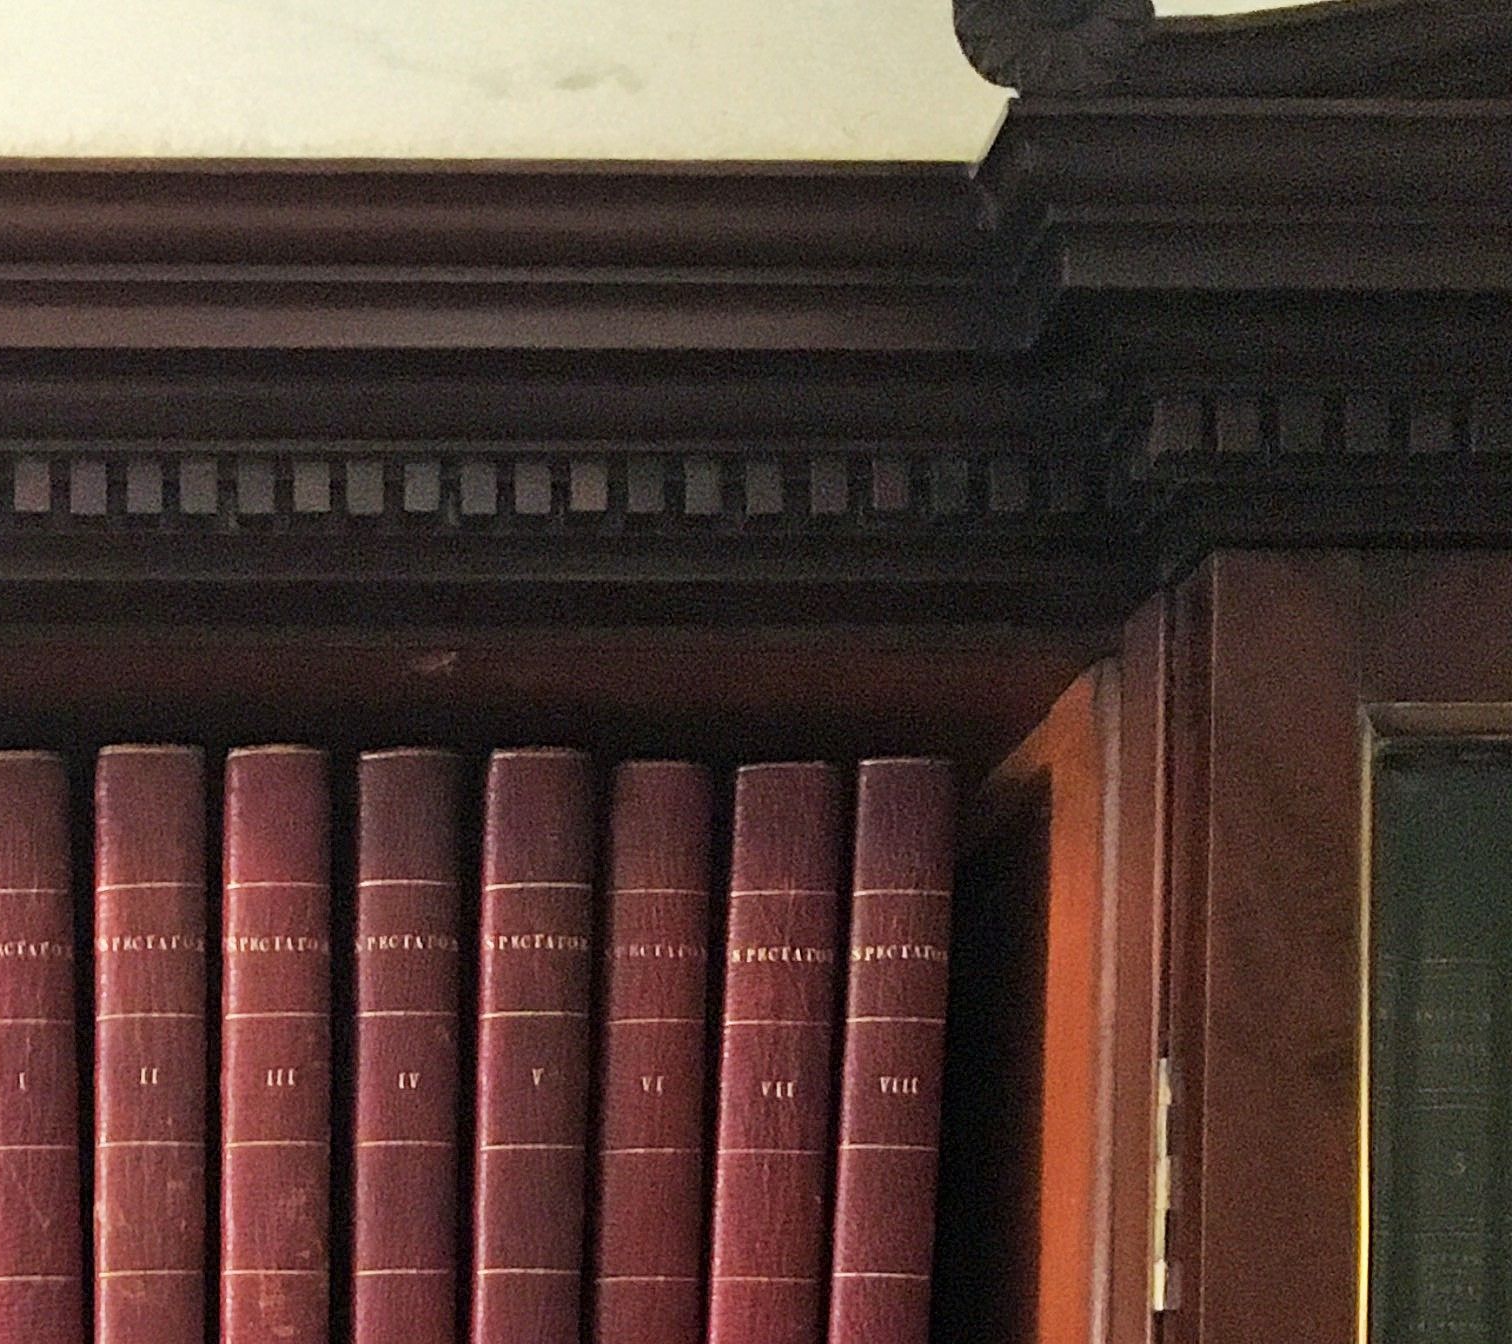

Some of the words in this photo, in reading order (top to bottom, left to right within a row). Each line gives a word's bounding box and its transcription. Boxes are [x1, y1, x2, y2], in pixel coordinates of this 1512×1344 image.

[18, 1072, 27, 1090] I
[140, 1068, 158, 1085] II
[266, 1069, 295, 1087] III
[398, 1073, 419, 1090] IV
[531, 1068, 544, 1086] V
[641, 1076, 664, 1094] VI
[880, 1076, 919, 1095] VIII
[761, 1081, 795, 1100] VII
